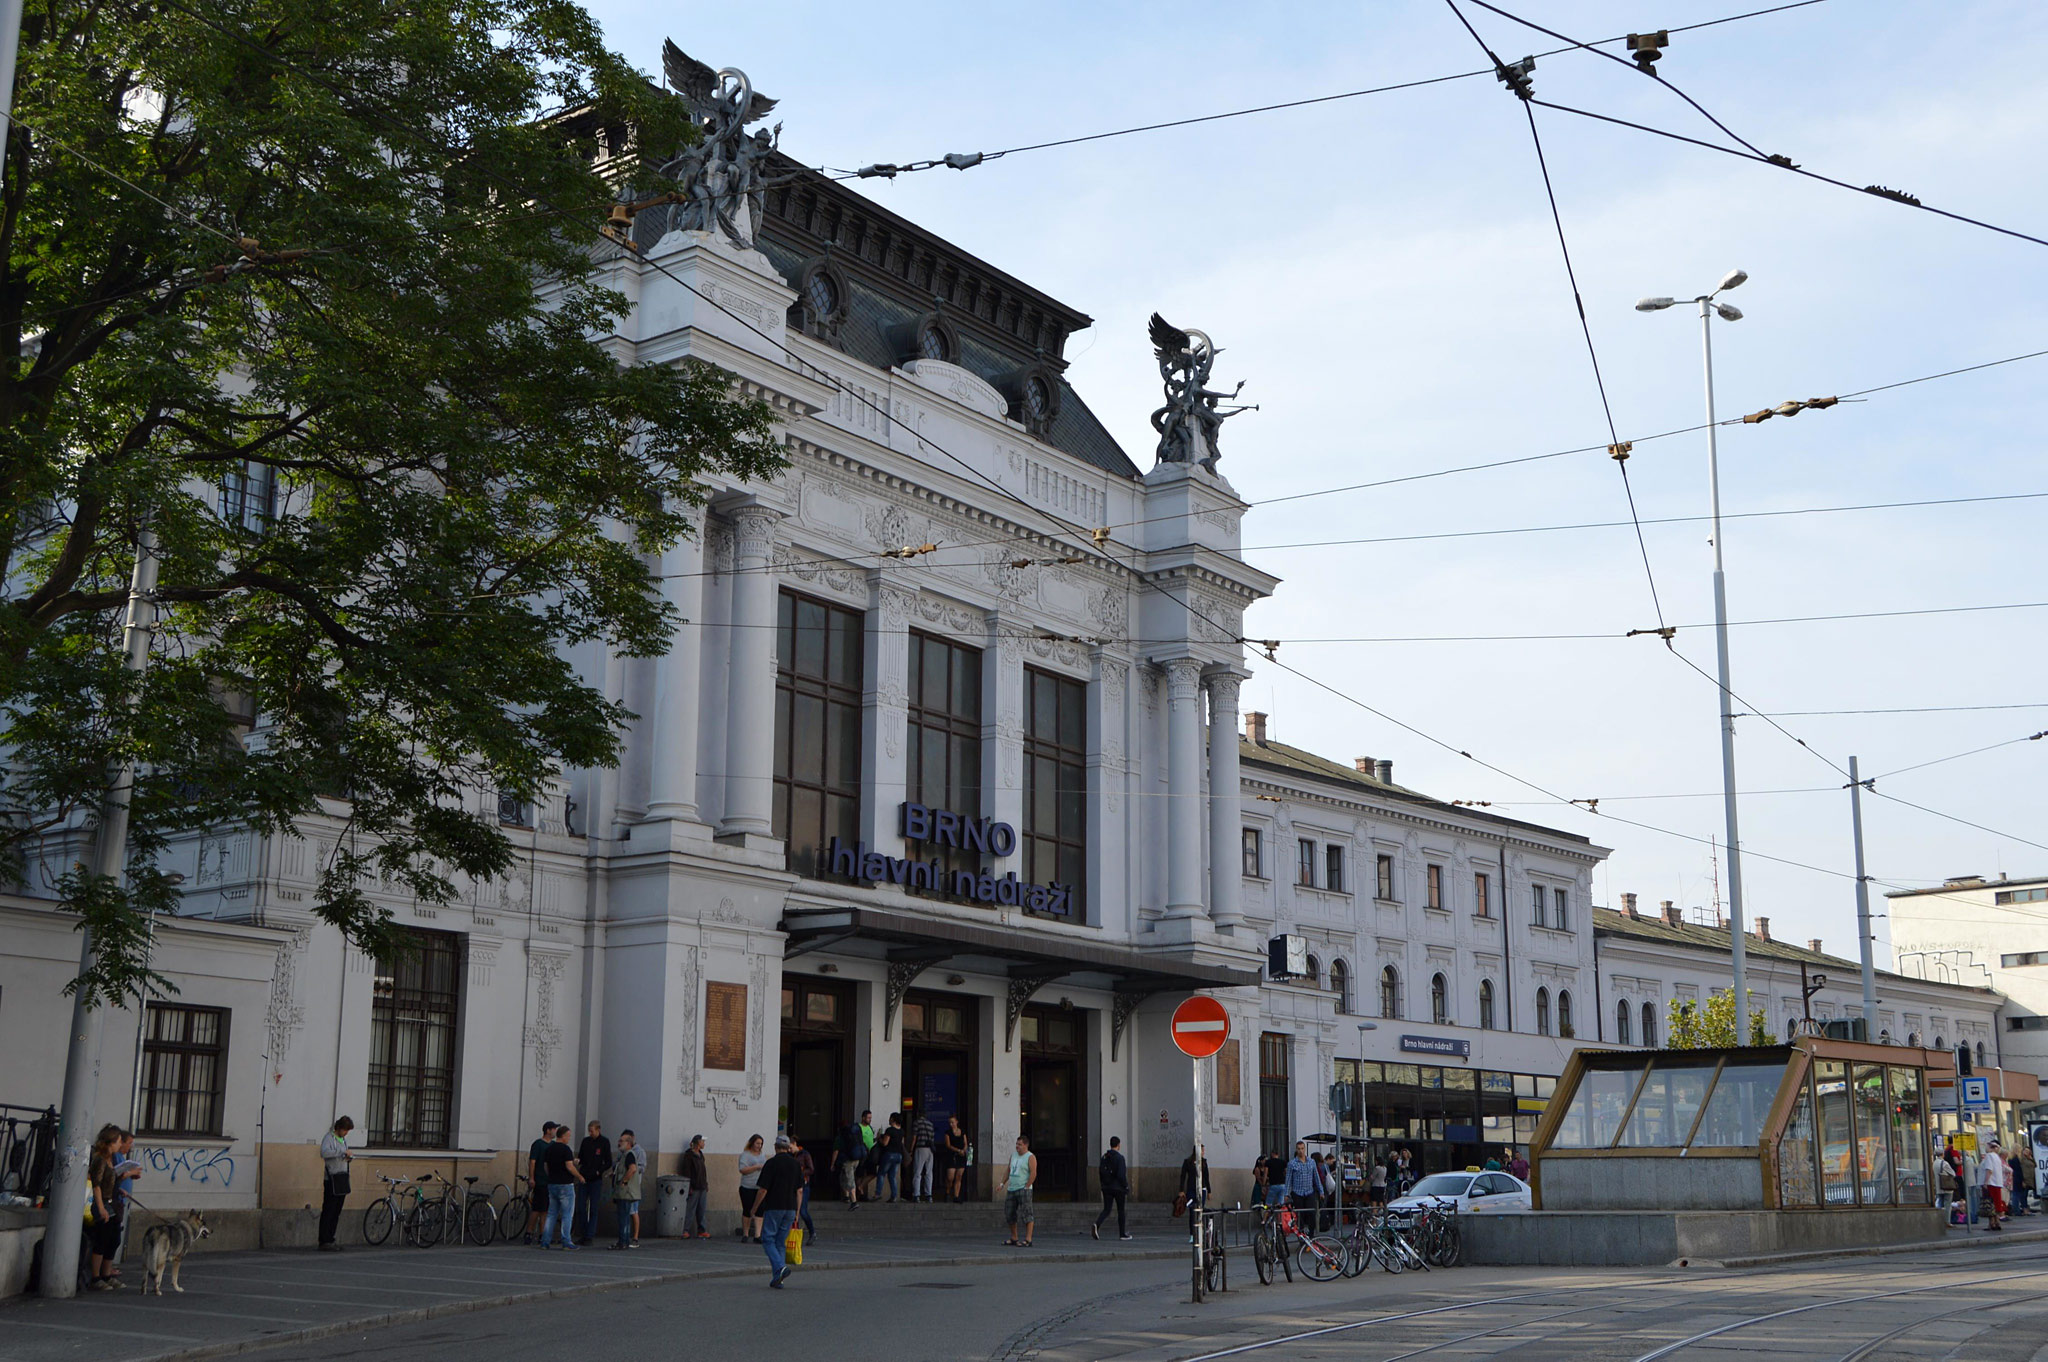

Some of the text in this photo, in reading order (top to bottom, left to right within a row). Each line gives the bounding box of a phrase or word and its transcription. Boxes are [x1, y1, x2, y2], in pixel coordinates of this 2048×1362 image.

[902, 801, 1016, 857] BRNO
[830, 836, 1074, 916] hlavní nádraží
[1404, 1039, 1454, 1051] Brno hlavní nádraží
